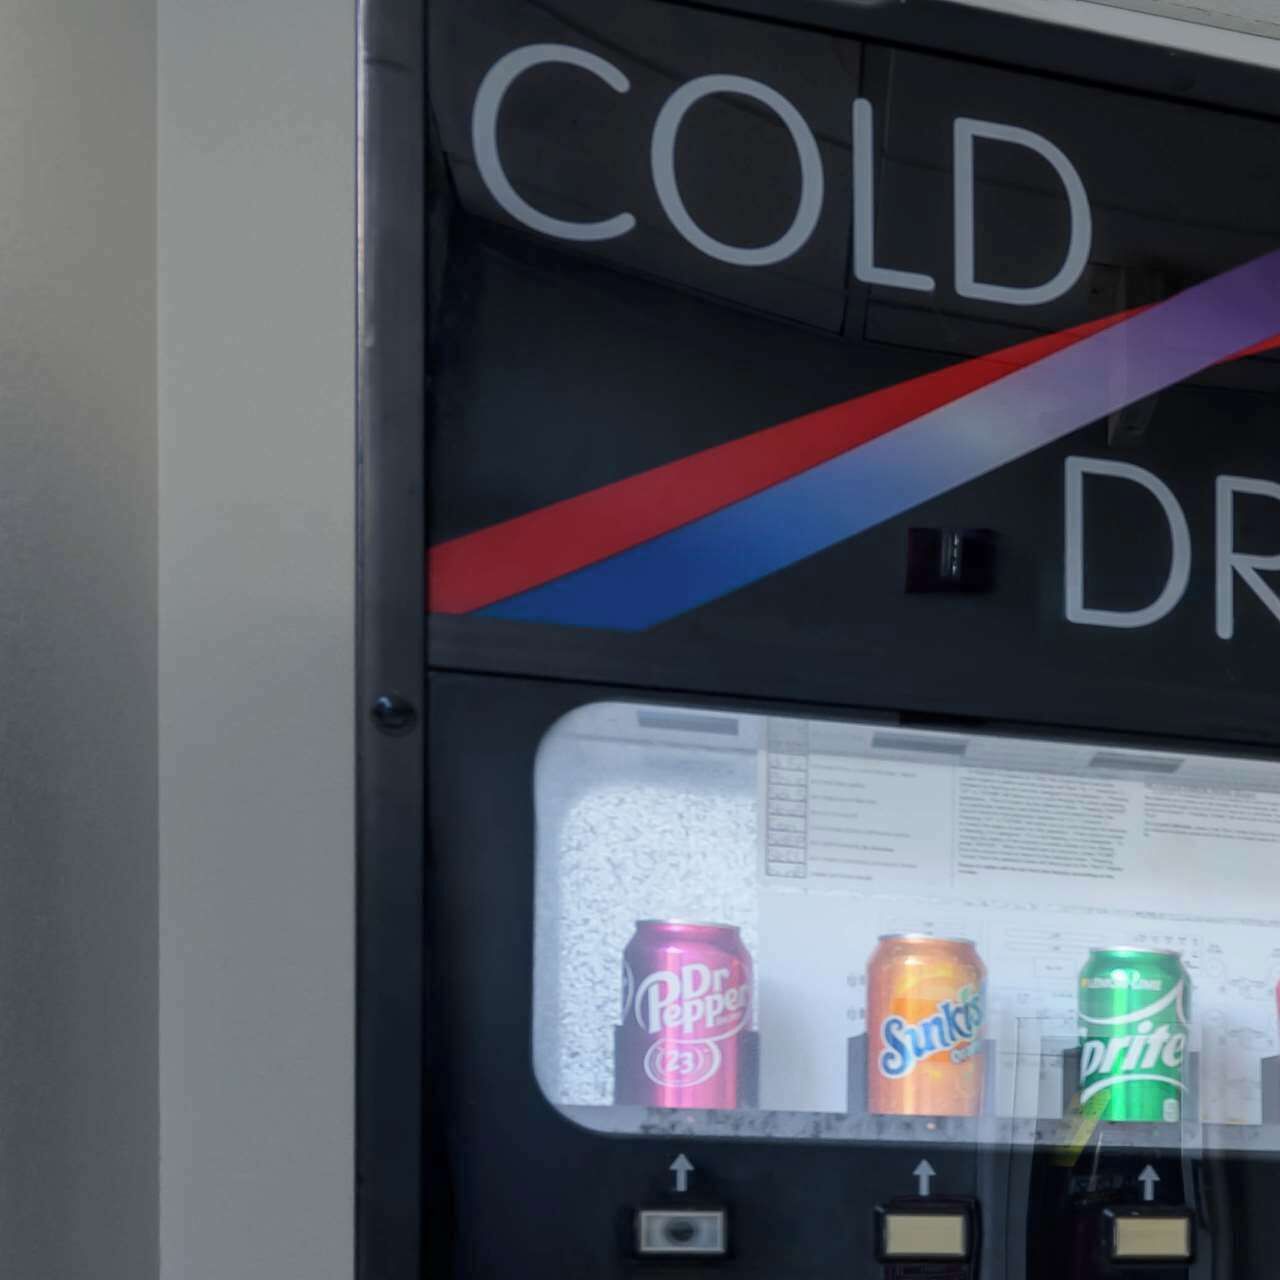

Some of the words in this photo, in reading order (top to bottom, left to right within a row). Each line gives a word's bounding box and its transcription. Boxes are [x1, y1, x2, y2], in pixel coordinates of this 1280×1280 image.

[469, 42, 1094, 306] COLD
[636, 970, 750, 1034] Pepper
[681, 962, 730, 1000] Dr
[667, 1050, 694, 1074] 23
[1080, 1020, 1184, 1086] prite
